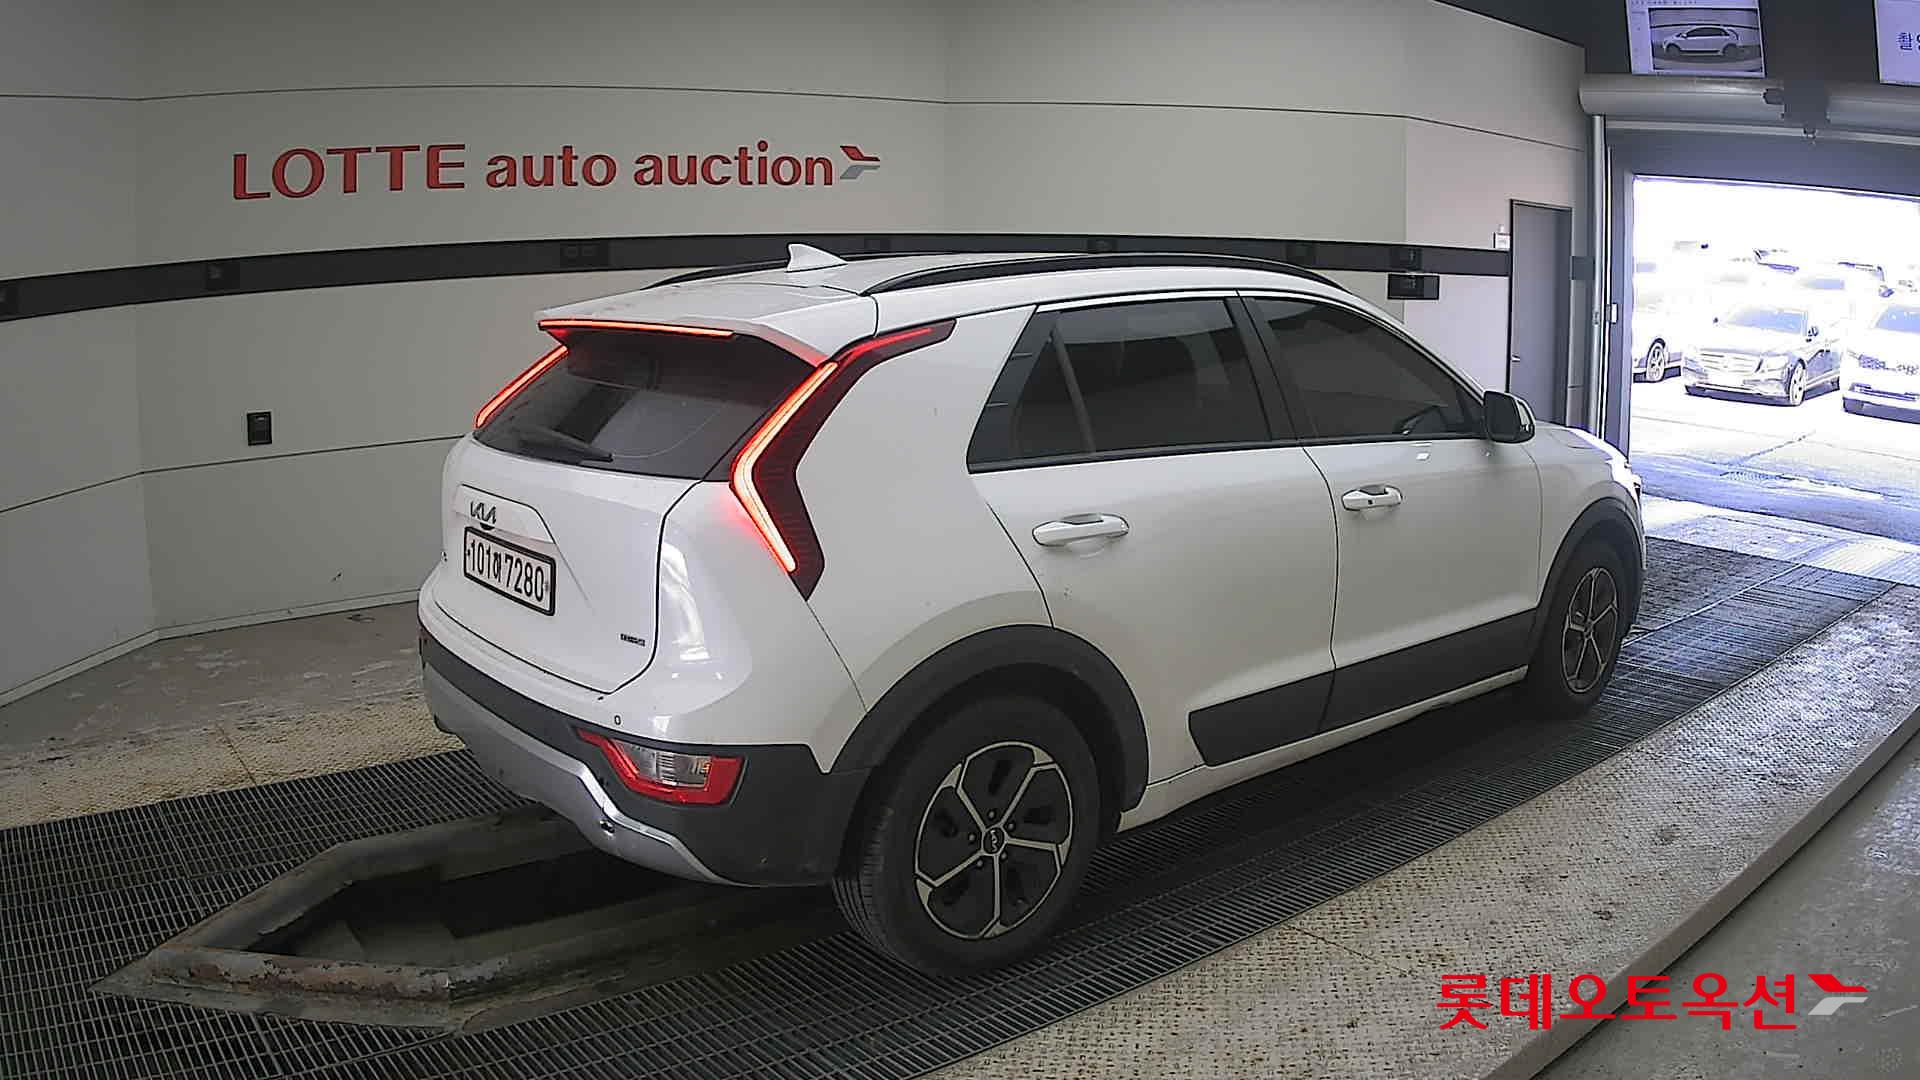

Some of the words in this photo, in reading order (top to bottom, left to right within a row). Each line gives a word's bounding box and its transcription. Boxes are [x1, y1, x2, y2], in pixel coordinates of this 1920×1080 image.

[233, 144, 466, 200] LOTTE
[486, 145, 617, 188] auto
[633, 140, 833, 187] auction
